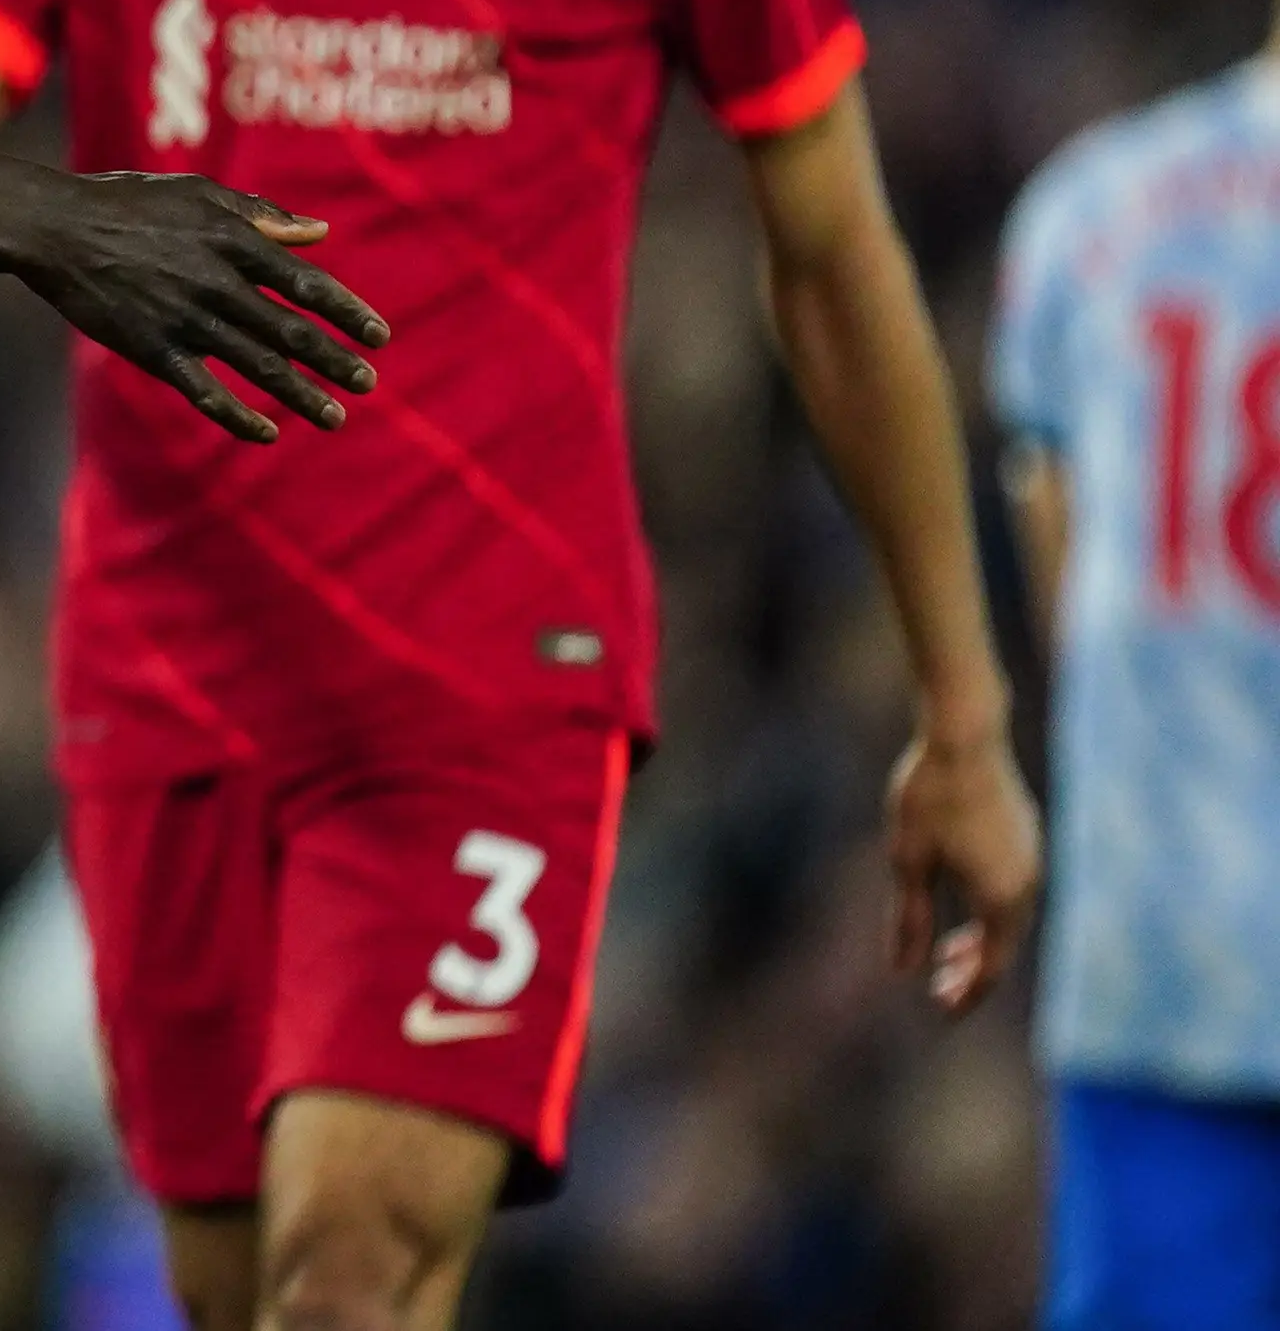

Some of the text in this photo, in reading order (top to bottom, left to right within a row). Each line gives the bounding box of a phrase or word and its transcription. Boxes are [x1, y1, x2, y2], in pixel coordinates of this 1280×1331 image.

[225, 8, 501, 73] standard
[220, 60, 512, 137] chartered
[428, 828, 548, 1008] 3
